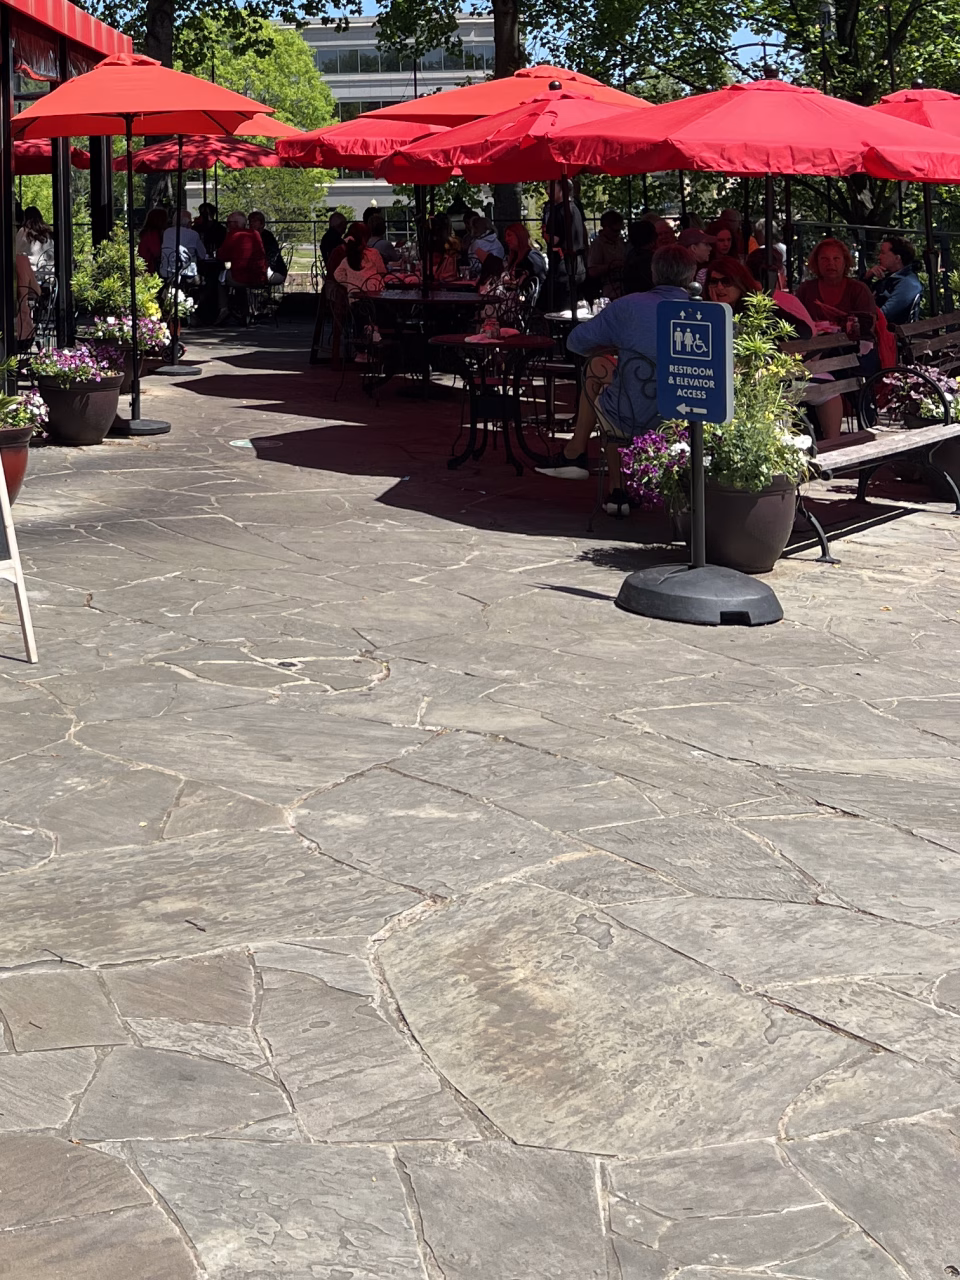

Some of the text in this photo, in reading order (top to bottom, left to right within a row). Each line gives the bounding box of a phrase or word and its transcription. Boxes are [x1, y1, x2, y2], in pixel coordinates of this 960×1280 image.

[669, 364, 714, 377] RESTROOM
[668, 375, 716, 389] & ELEVATOR
[676, 388, 707, 399] ACCESS
